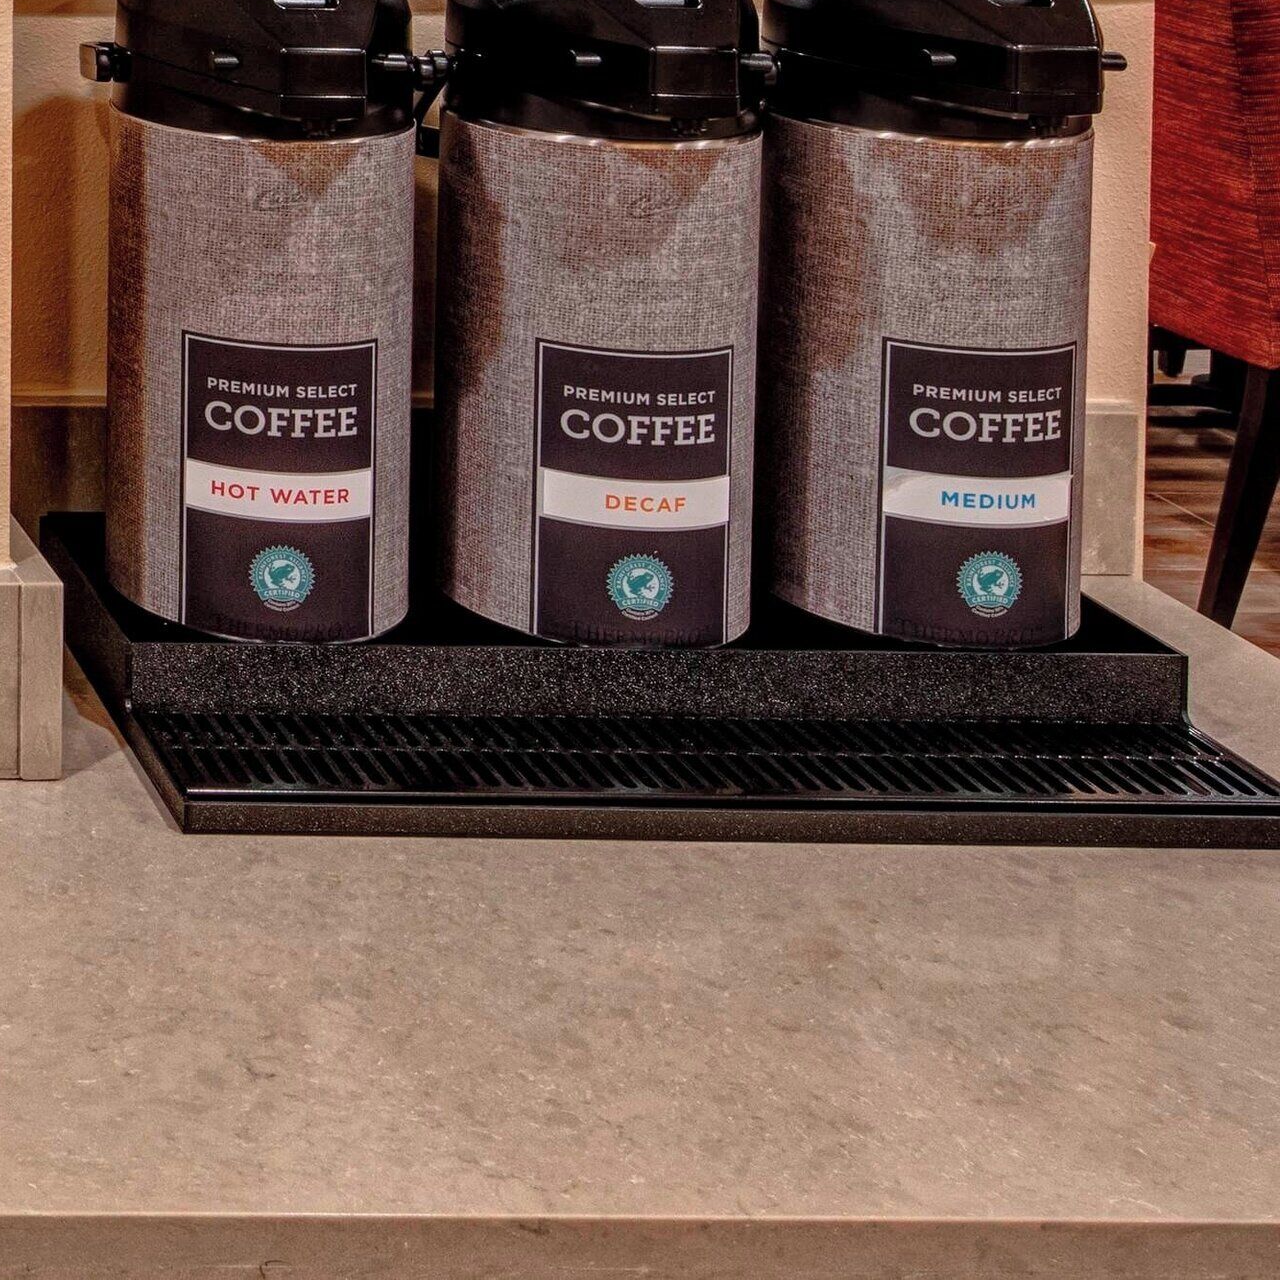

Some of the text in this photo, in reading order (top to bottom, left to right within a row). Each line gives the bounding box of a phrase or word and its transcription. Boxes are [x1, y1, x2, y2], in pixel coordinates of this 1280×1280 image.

[207, 376, 358, 399] PREMIUM SELECT
[563, 384, 716, 406] PREMIUM SELECT
[912, 383, 1062, 403] PREMIUM SELECT
[204, 400, 358, 438] COFFEE
[560, 408, 715, 446] COFFEE
[908, 407, 1062, 443] COFFEE
[211, 480, 350, 505] HOT WATER
[941, 491, 1036, 510] MEDIUM
[605, 494, 686, 513] DECAF
[263, 589, 302, 599] CERTIFIED
[621, 598, 660, 608] CERTIFIED
[971, 595, 1009, 605] CERTIFIED
